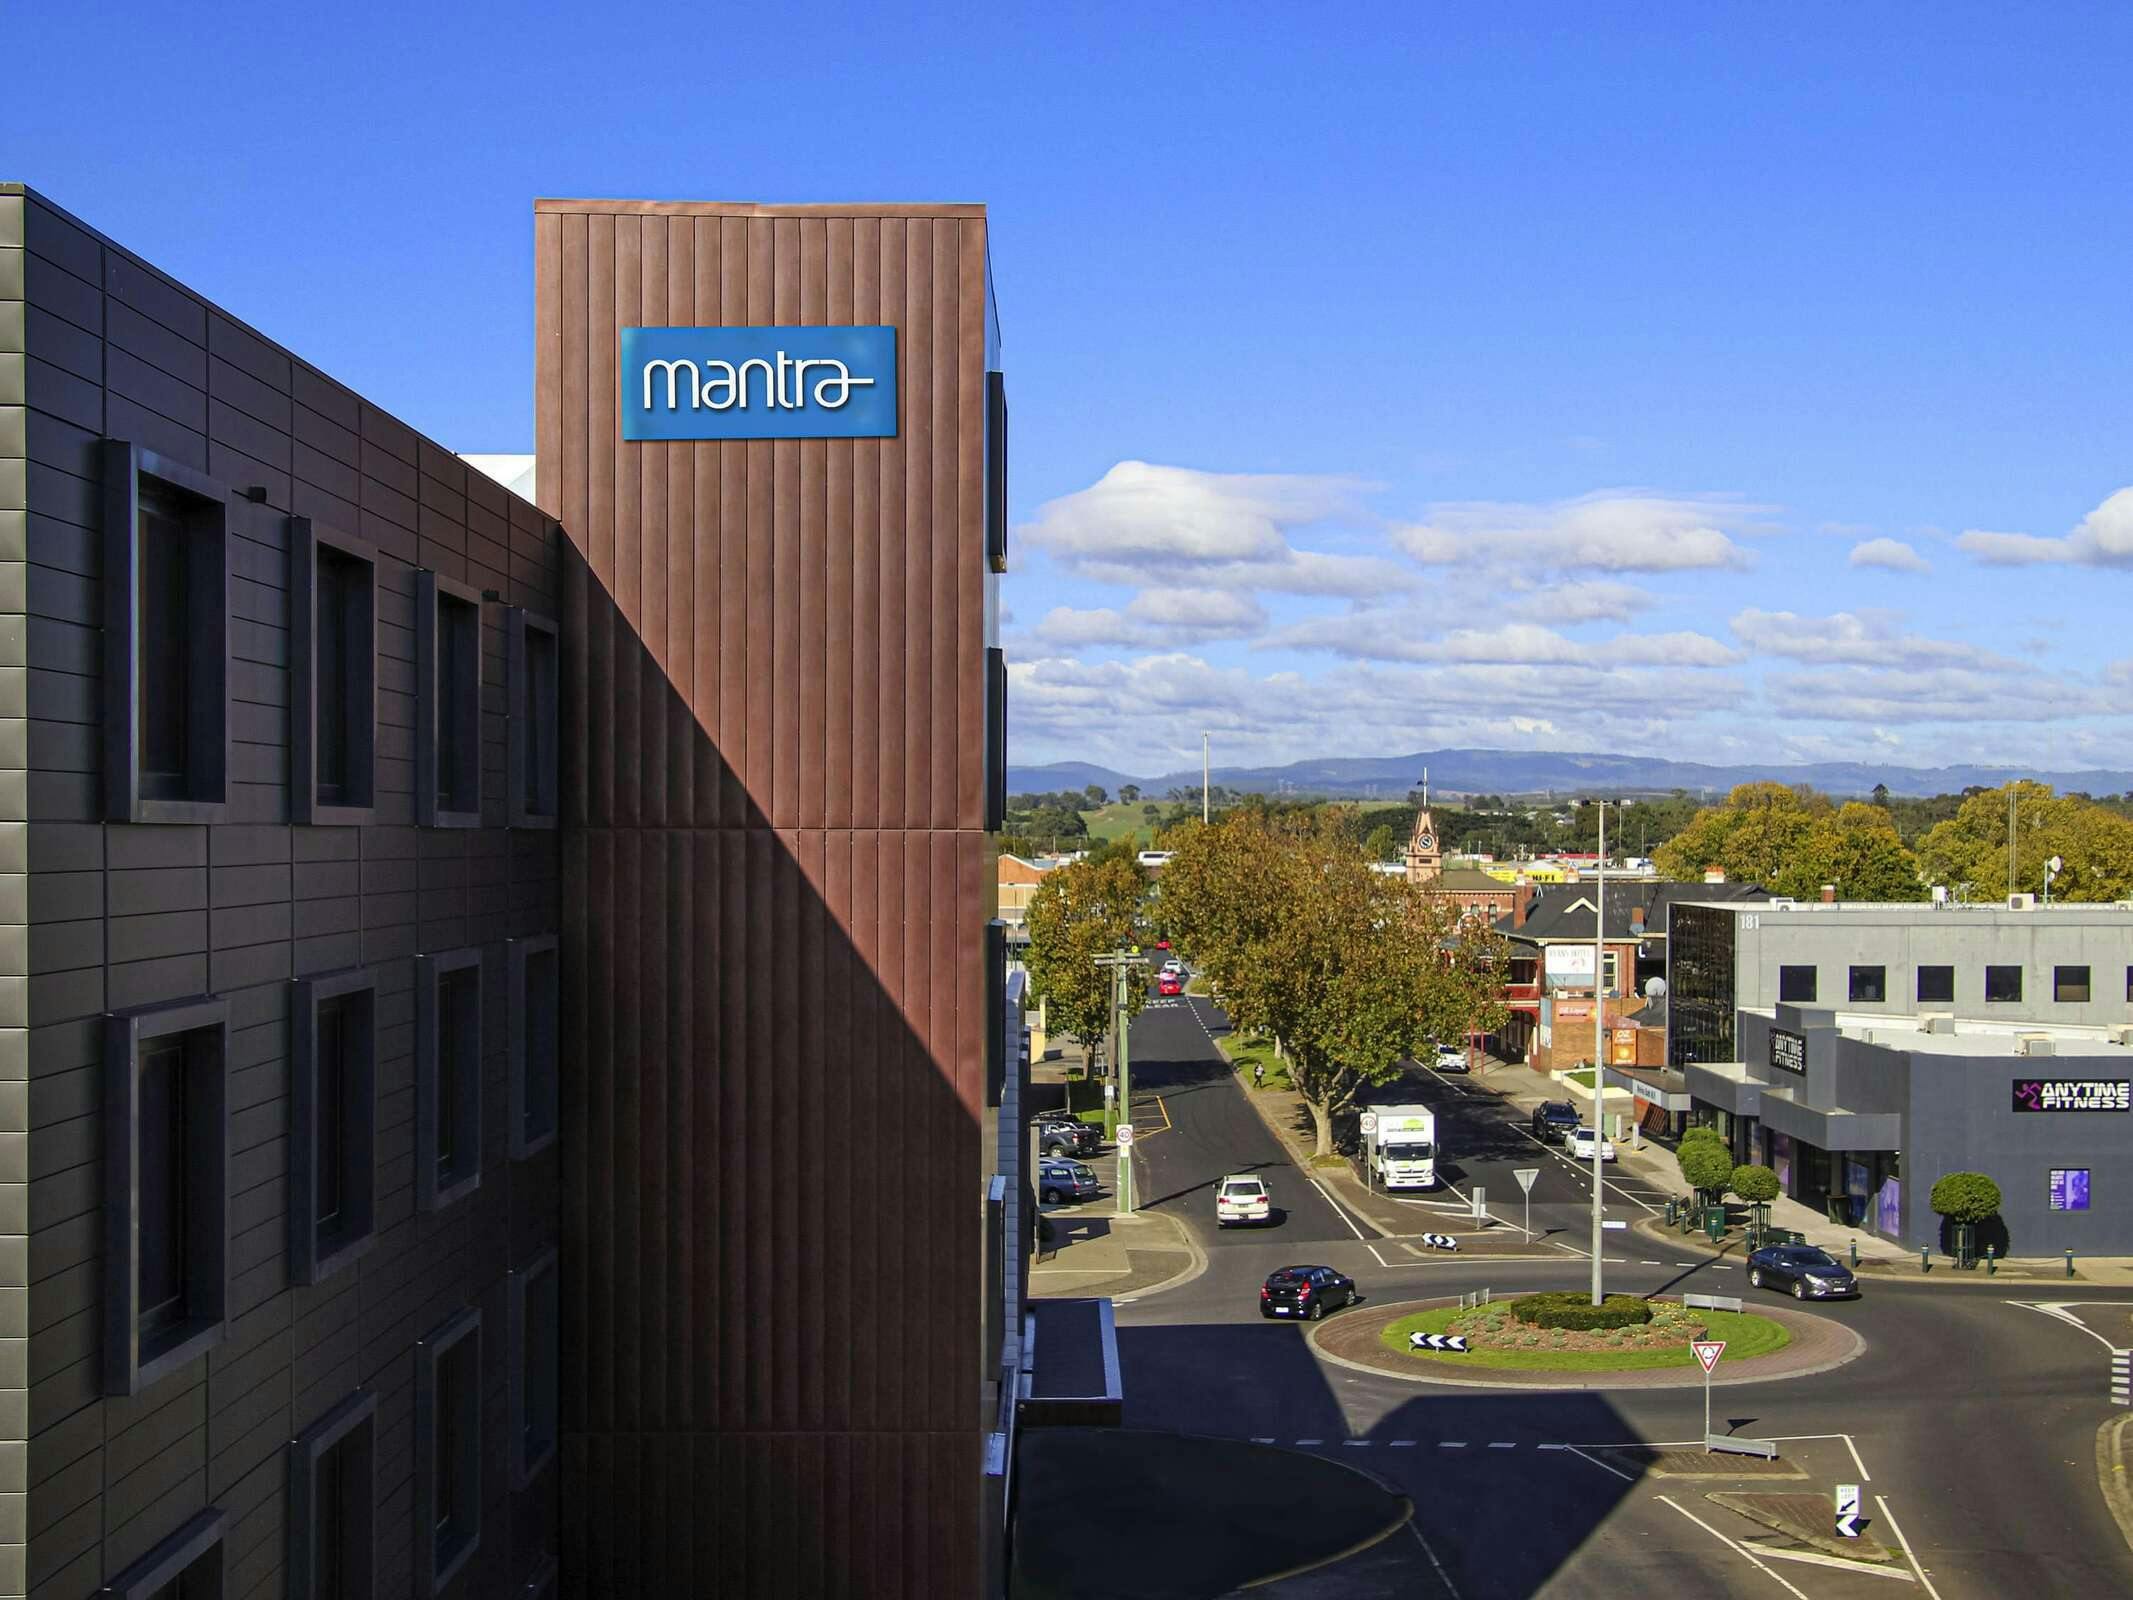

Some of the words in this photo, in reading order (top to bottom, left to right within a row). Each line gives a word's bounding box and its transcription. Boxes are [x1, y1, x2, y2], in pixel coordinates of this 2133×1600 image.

[643, 350, 875, 409] mantra
[1740, 914, 1760, 929] 181
[1775, 1050, 1803, 1071] FITNESS
[2040, 1082, 2130, 1097] ANYTIME
[2042, 1096, 2130, 1109] FITNESS
[1363, 1119, 1374, 1127] 40
[1119, 1131, 1130, 1139] 40
